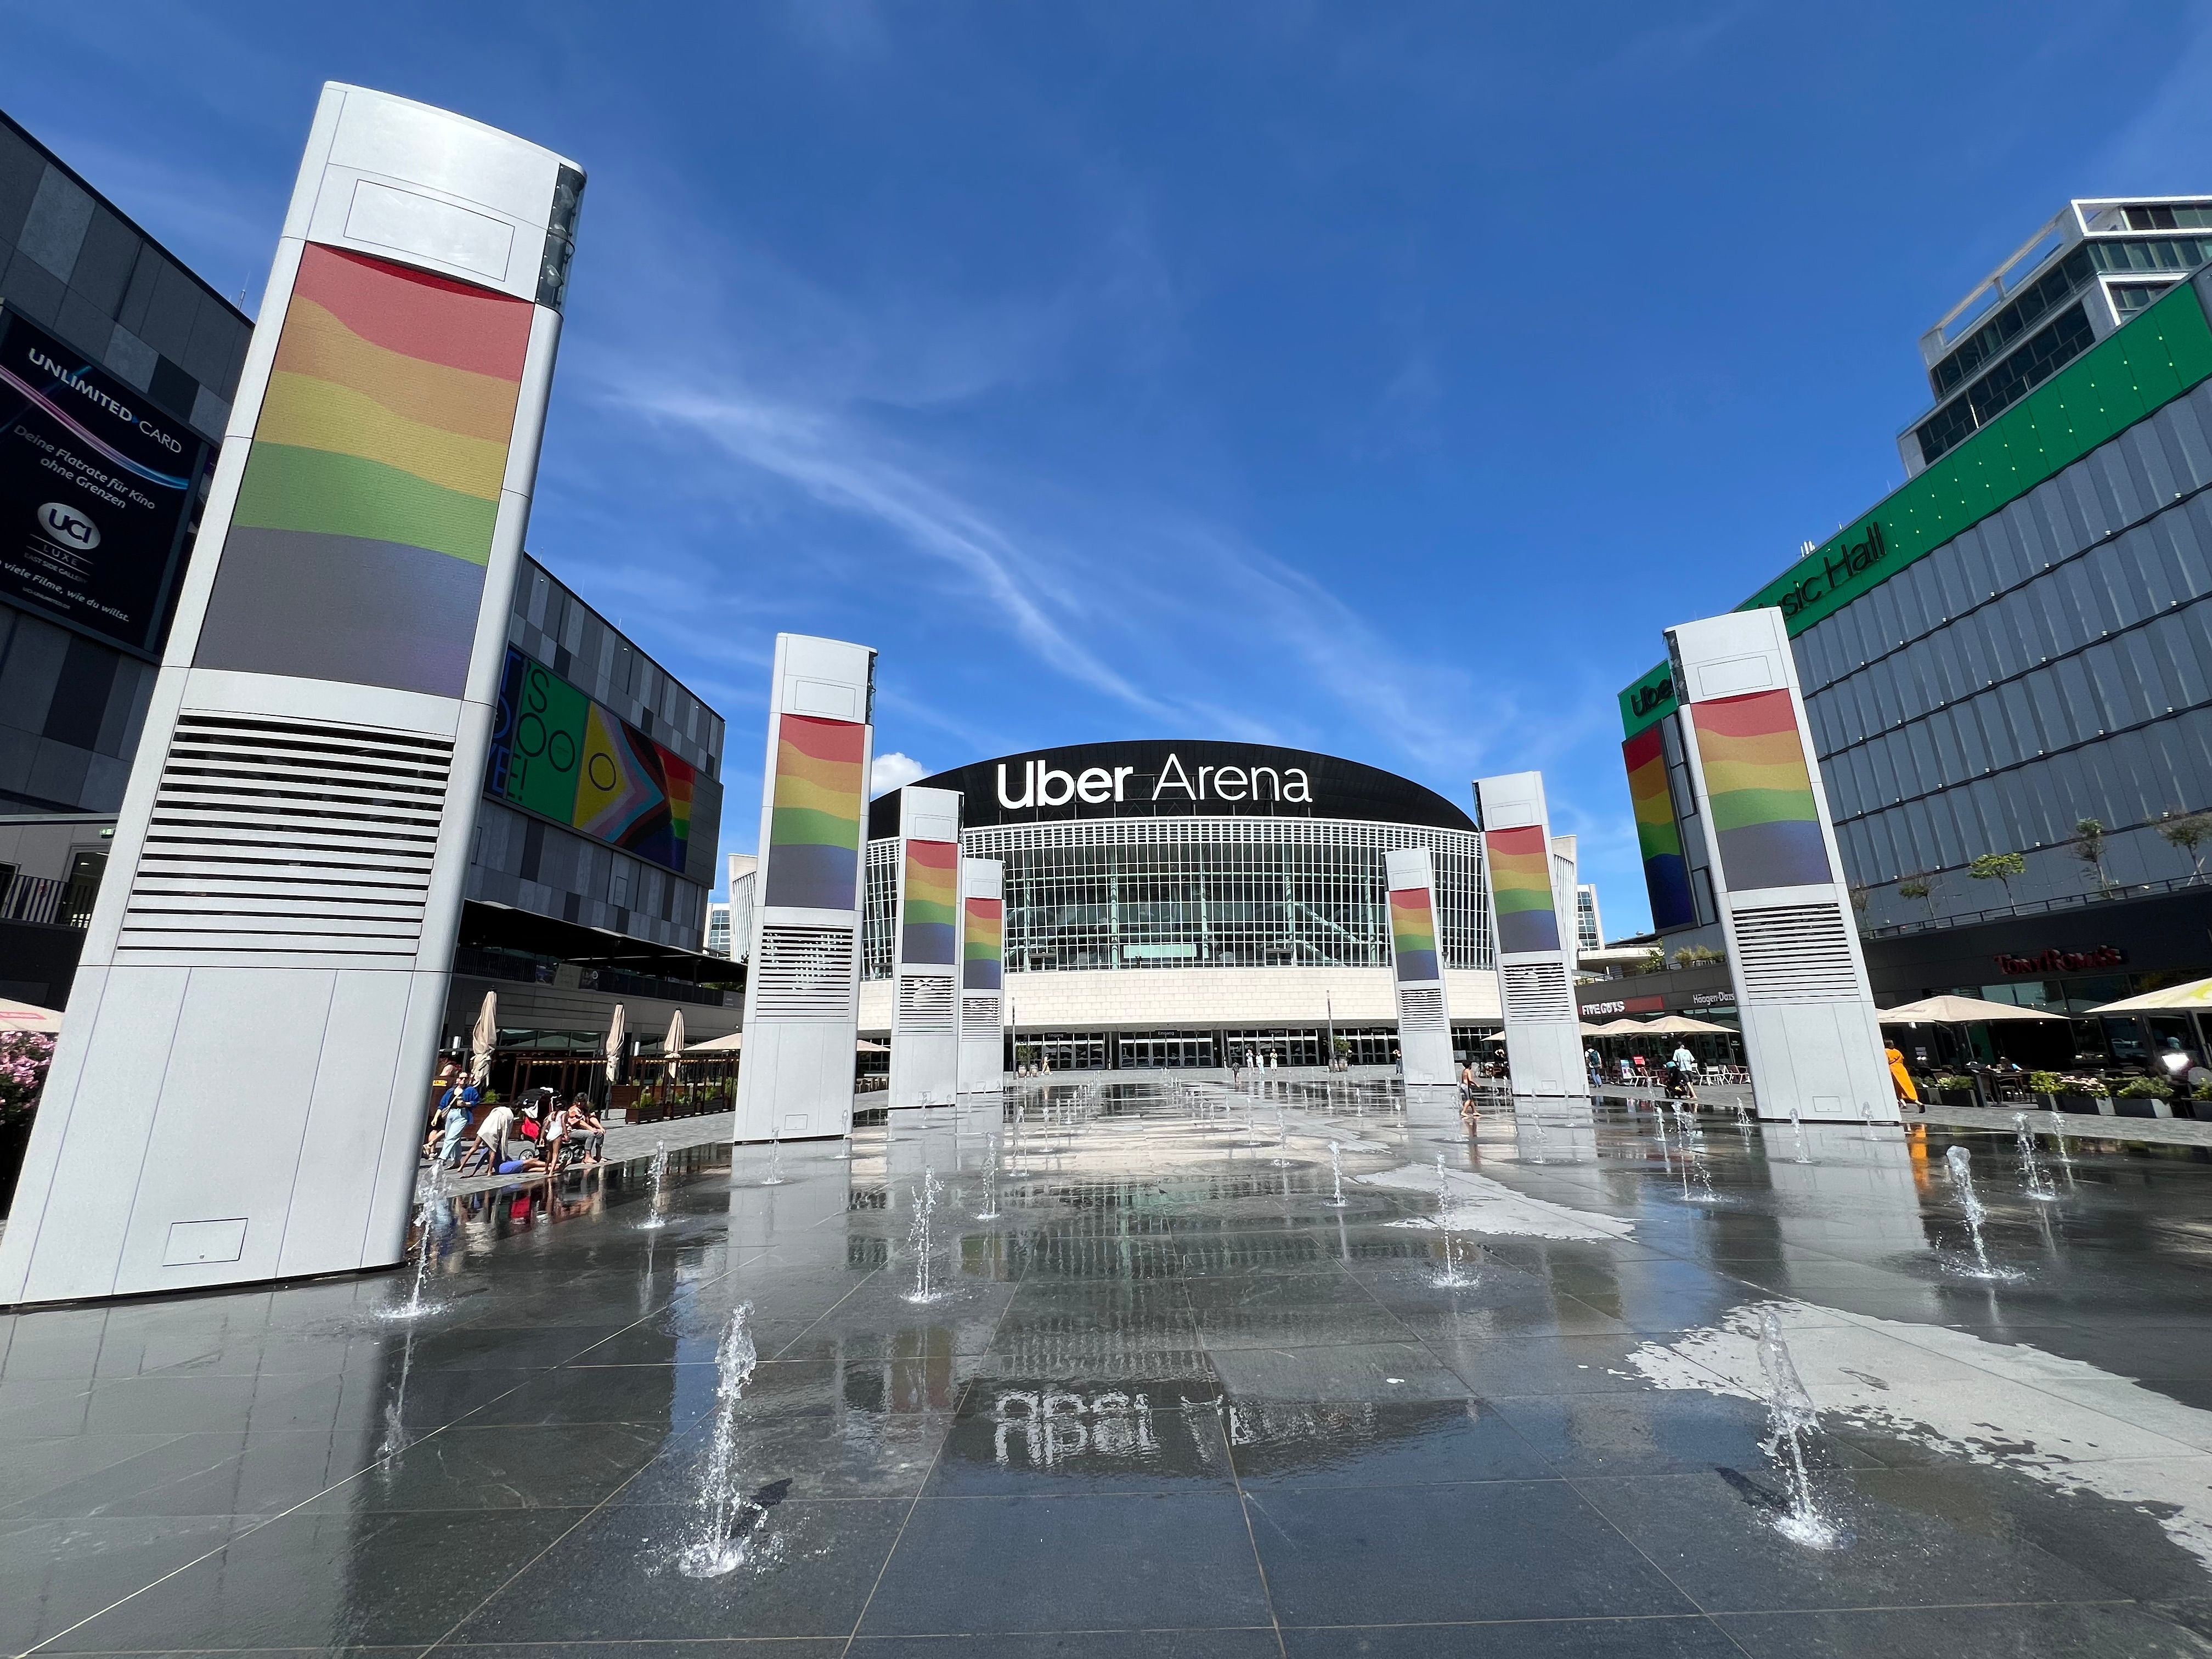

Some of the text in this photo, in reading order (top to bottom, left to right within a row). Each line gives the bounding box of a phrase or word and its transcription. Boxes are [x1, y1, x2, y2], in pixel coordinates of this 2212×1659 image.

[29, 348, 182, 453] UNLIMITED CARD
[14, 425, 155, 509] Deine Flatrate für Kino
[40, 458, 126, 509] ohne Grenzen
[49, 508, 92, 544] UCI
[43, 545, 79, 566] LUXE
[1776, 521, 1886, 617] sic Hall
[4, 563, 31, 579] viele
[67, 590, 85, 602] wie
[86, 599, 99, 608] du
[998, 753, 1313, 809] Uber Arena
[1582, 1001, 1625, 1015] FIVE GUYS
